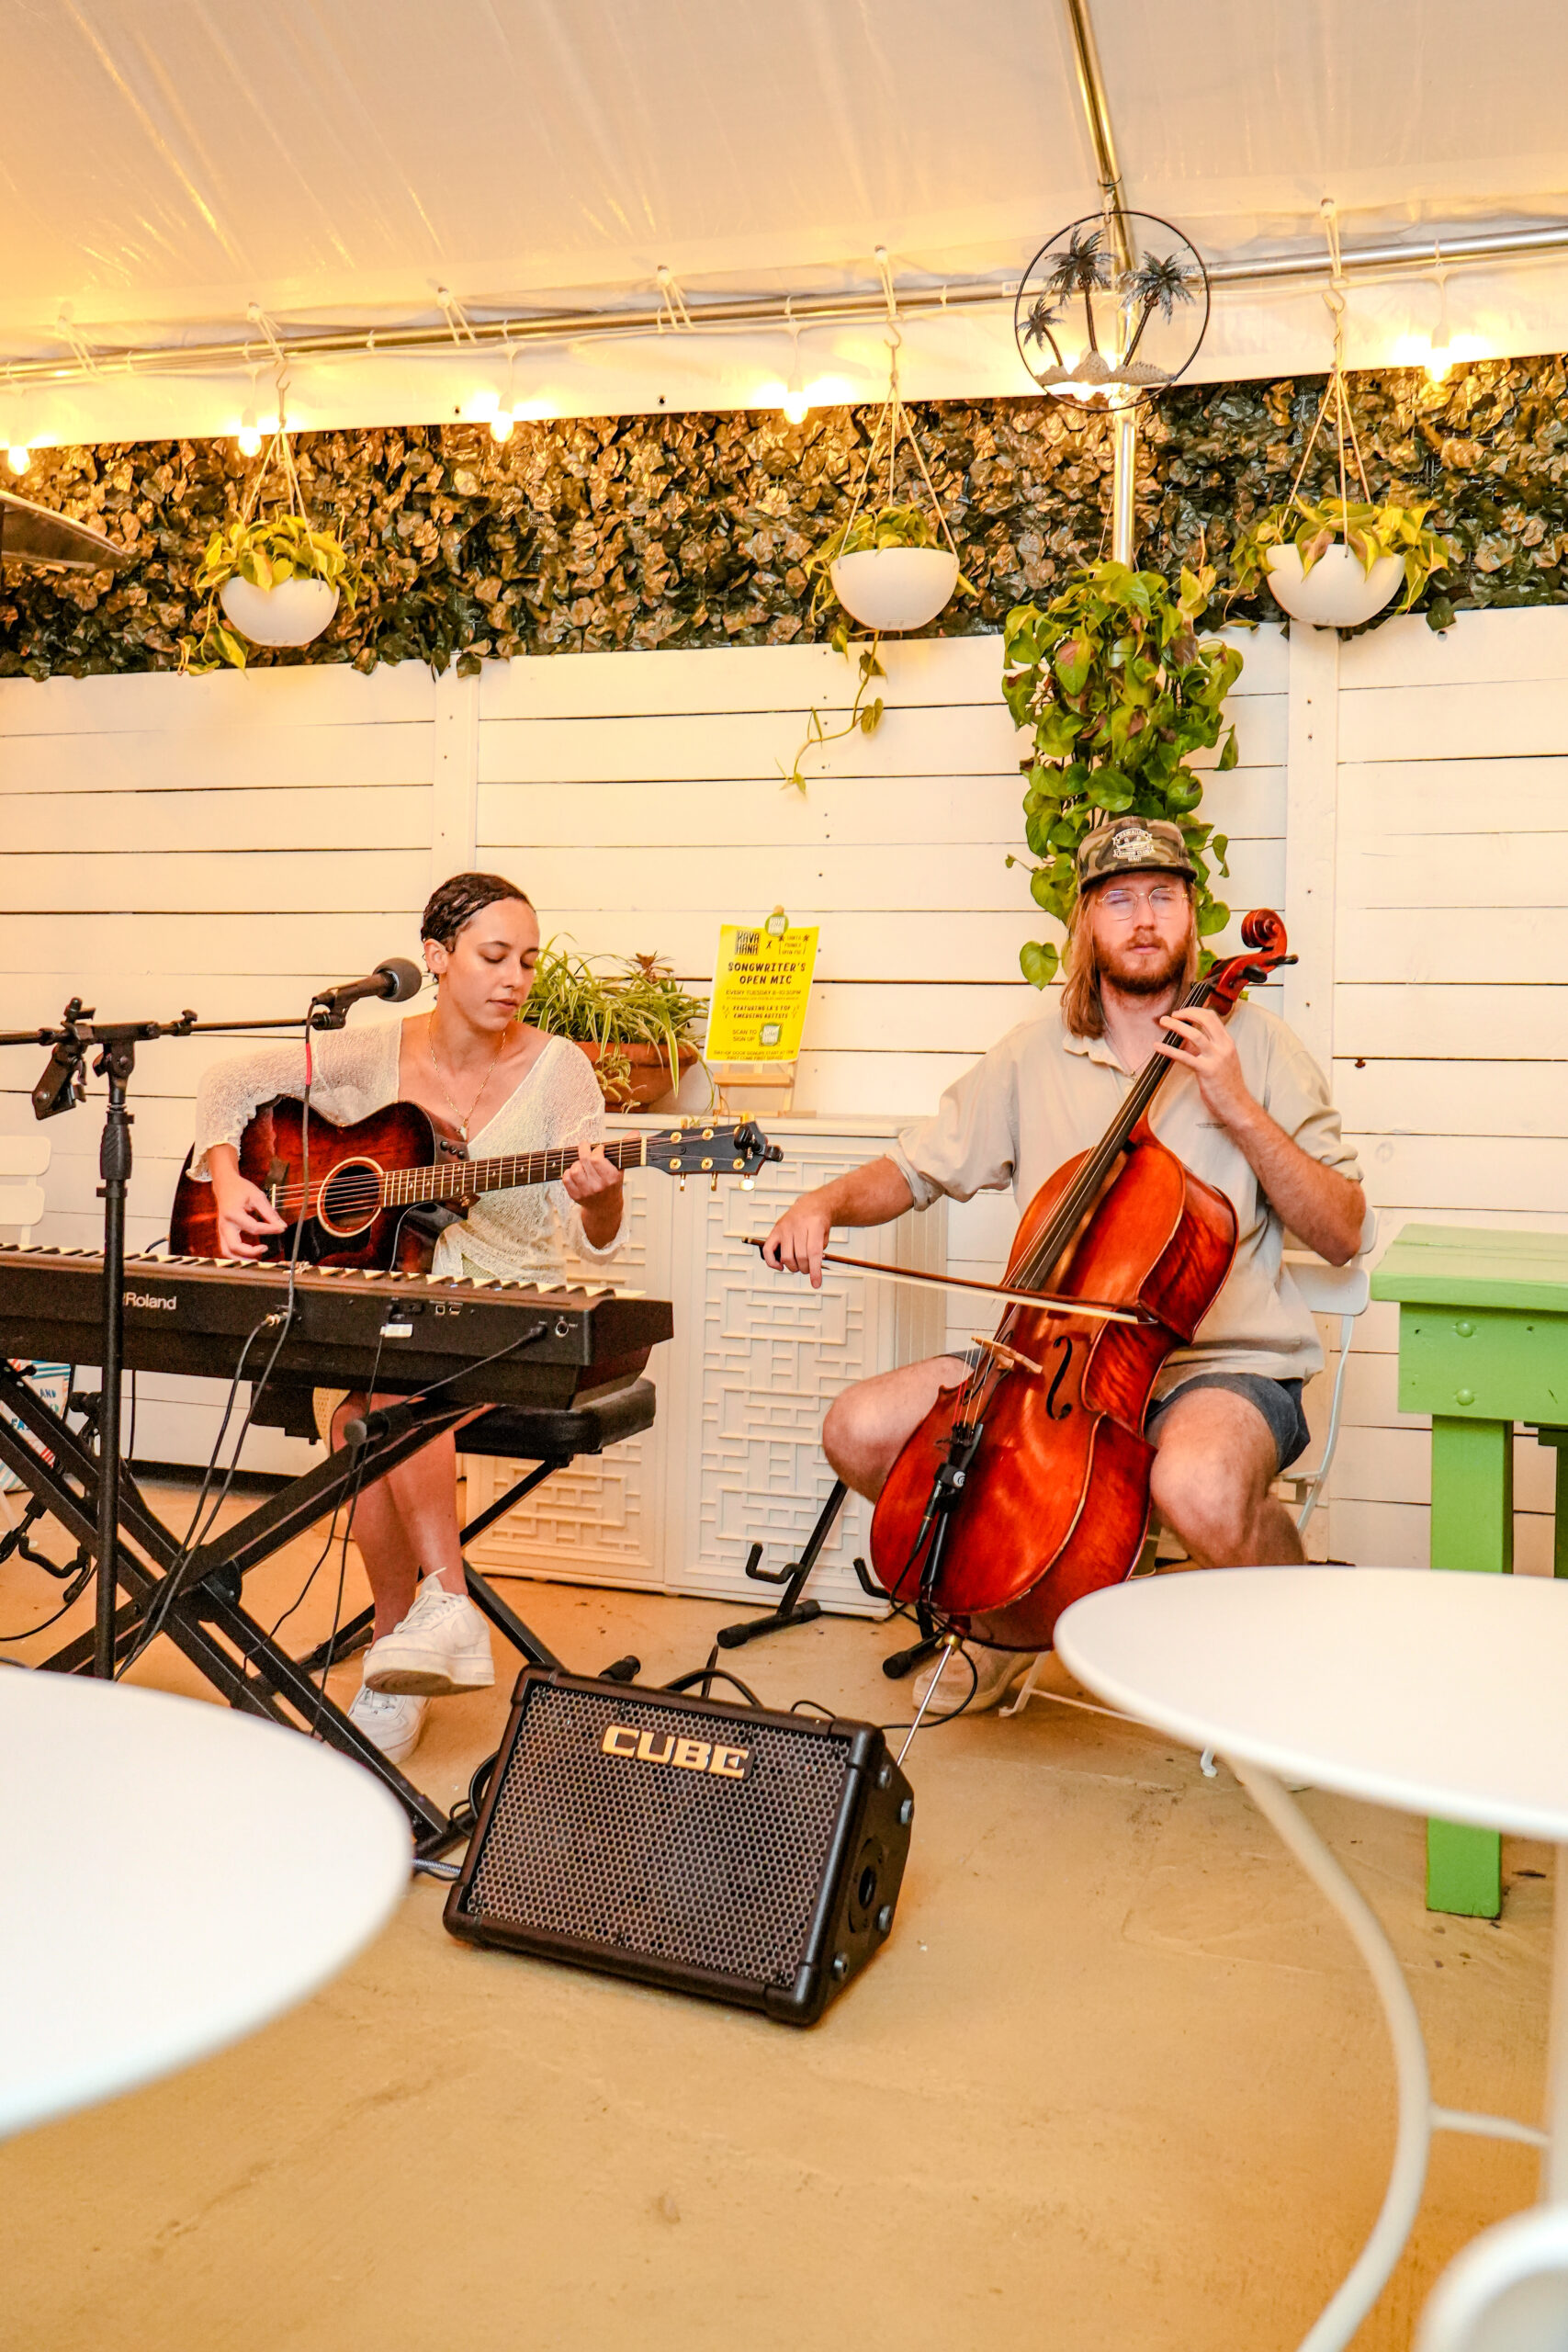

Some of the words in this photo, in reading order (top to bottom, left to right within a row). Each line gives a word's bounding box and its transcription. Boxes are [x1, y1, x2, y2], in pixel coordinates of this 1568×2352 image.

[737, 931, 761, 944] KAVA
[736, 943, 759, 956] HANA
[728, 962, 807, 972] SONGWRITER'S
[739, 975, 767, 985] OPEN
[770, 975, 793, 985] MIC
[125, 1291, 177, 1311] Roland
[39, 1387, 57, 1398] AND
[602, 1724, 750, 1780] CUBE
